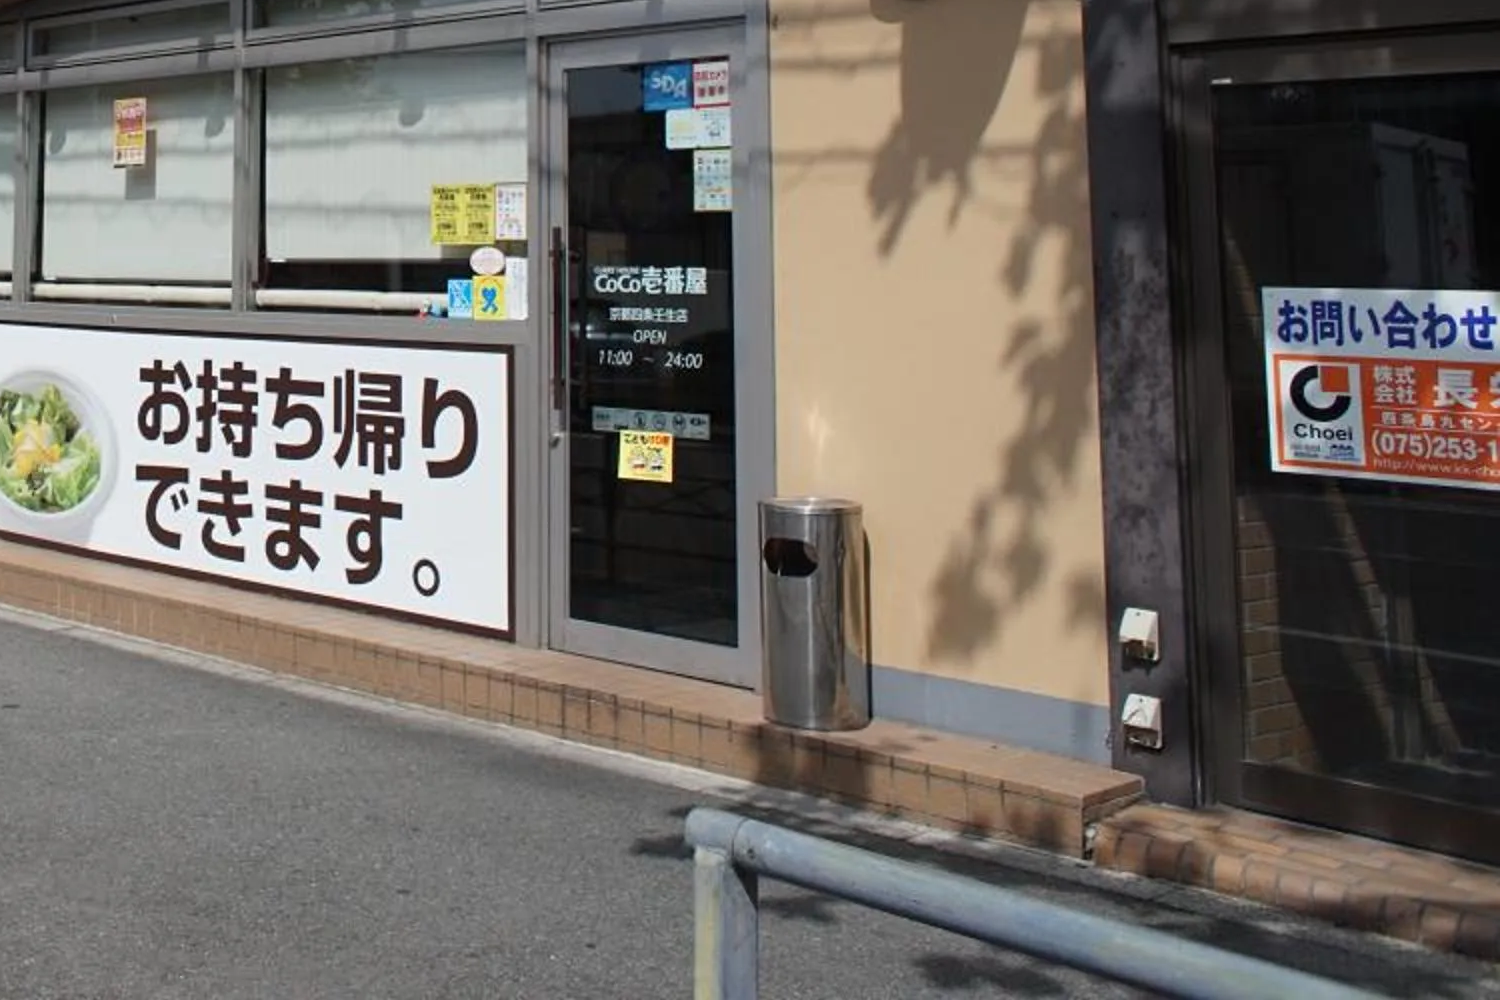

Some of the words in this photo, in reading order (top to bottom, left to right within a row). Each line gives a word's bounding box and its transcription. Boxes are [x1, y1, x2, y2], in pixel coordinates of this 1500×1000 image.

[595, 266, 708, 295] CoCo壱番屋
[633, 329, 667, 345] OPEN
[1277, 300, 1497, 350] お問い合わせ
[599, 349, 633, 366] 11:00
[664, 352, 703, 369] 24:00
[137, 359, 480, 480] お持ち帰り
[1294, 423, 1353, 441] Choei
[1371, 430, 1498, 465] (075)253-1
[135, 463, 440, 597] できます。
